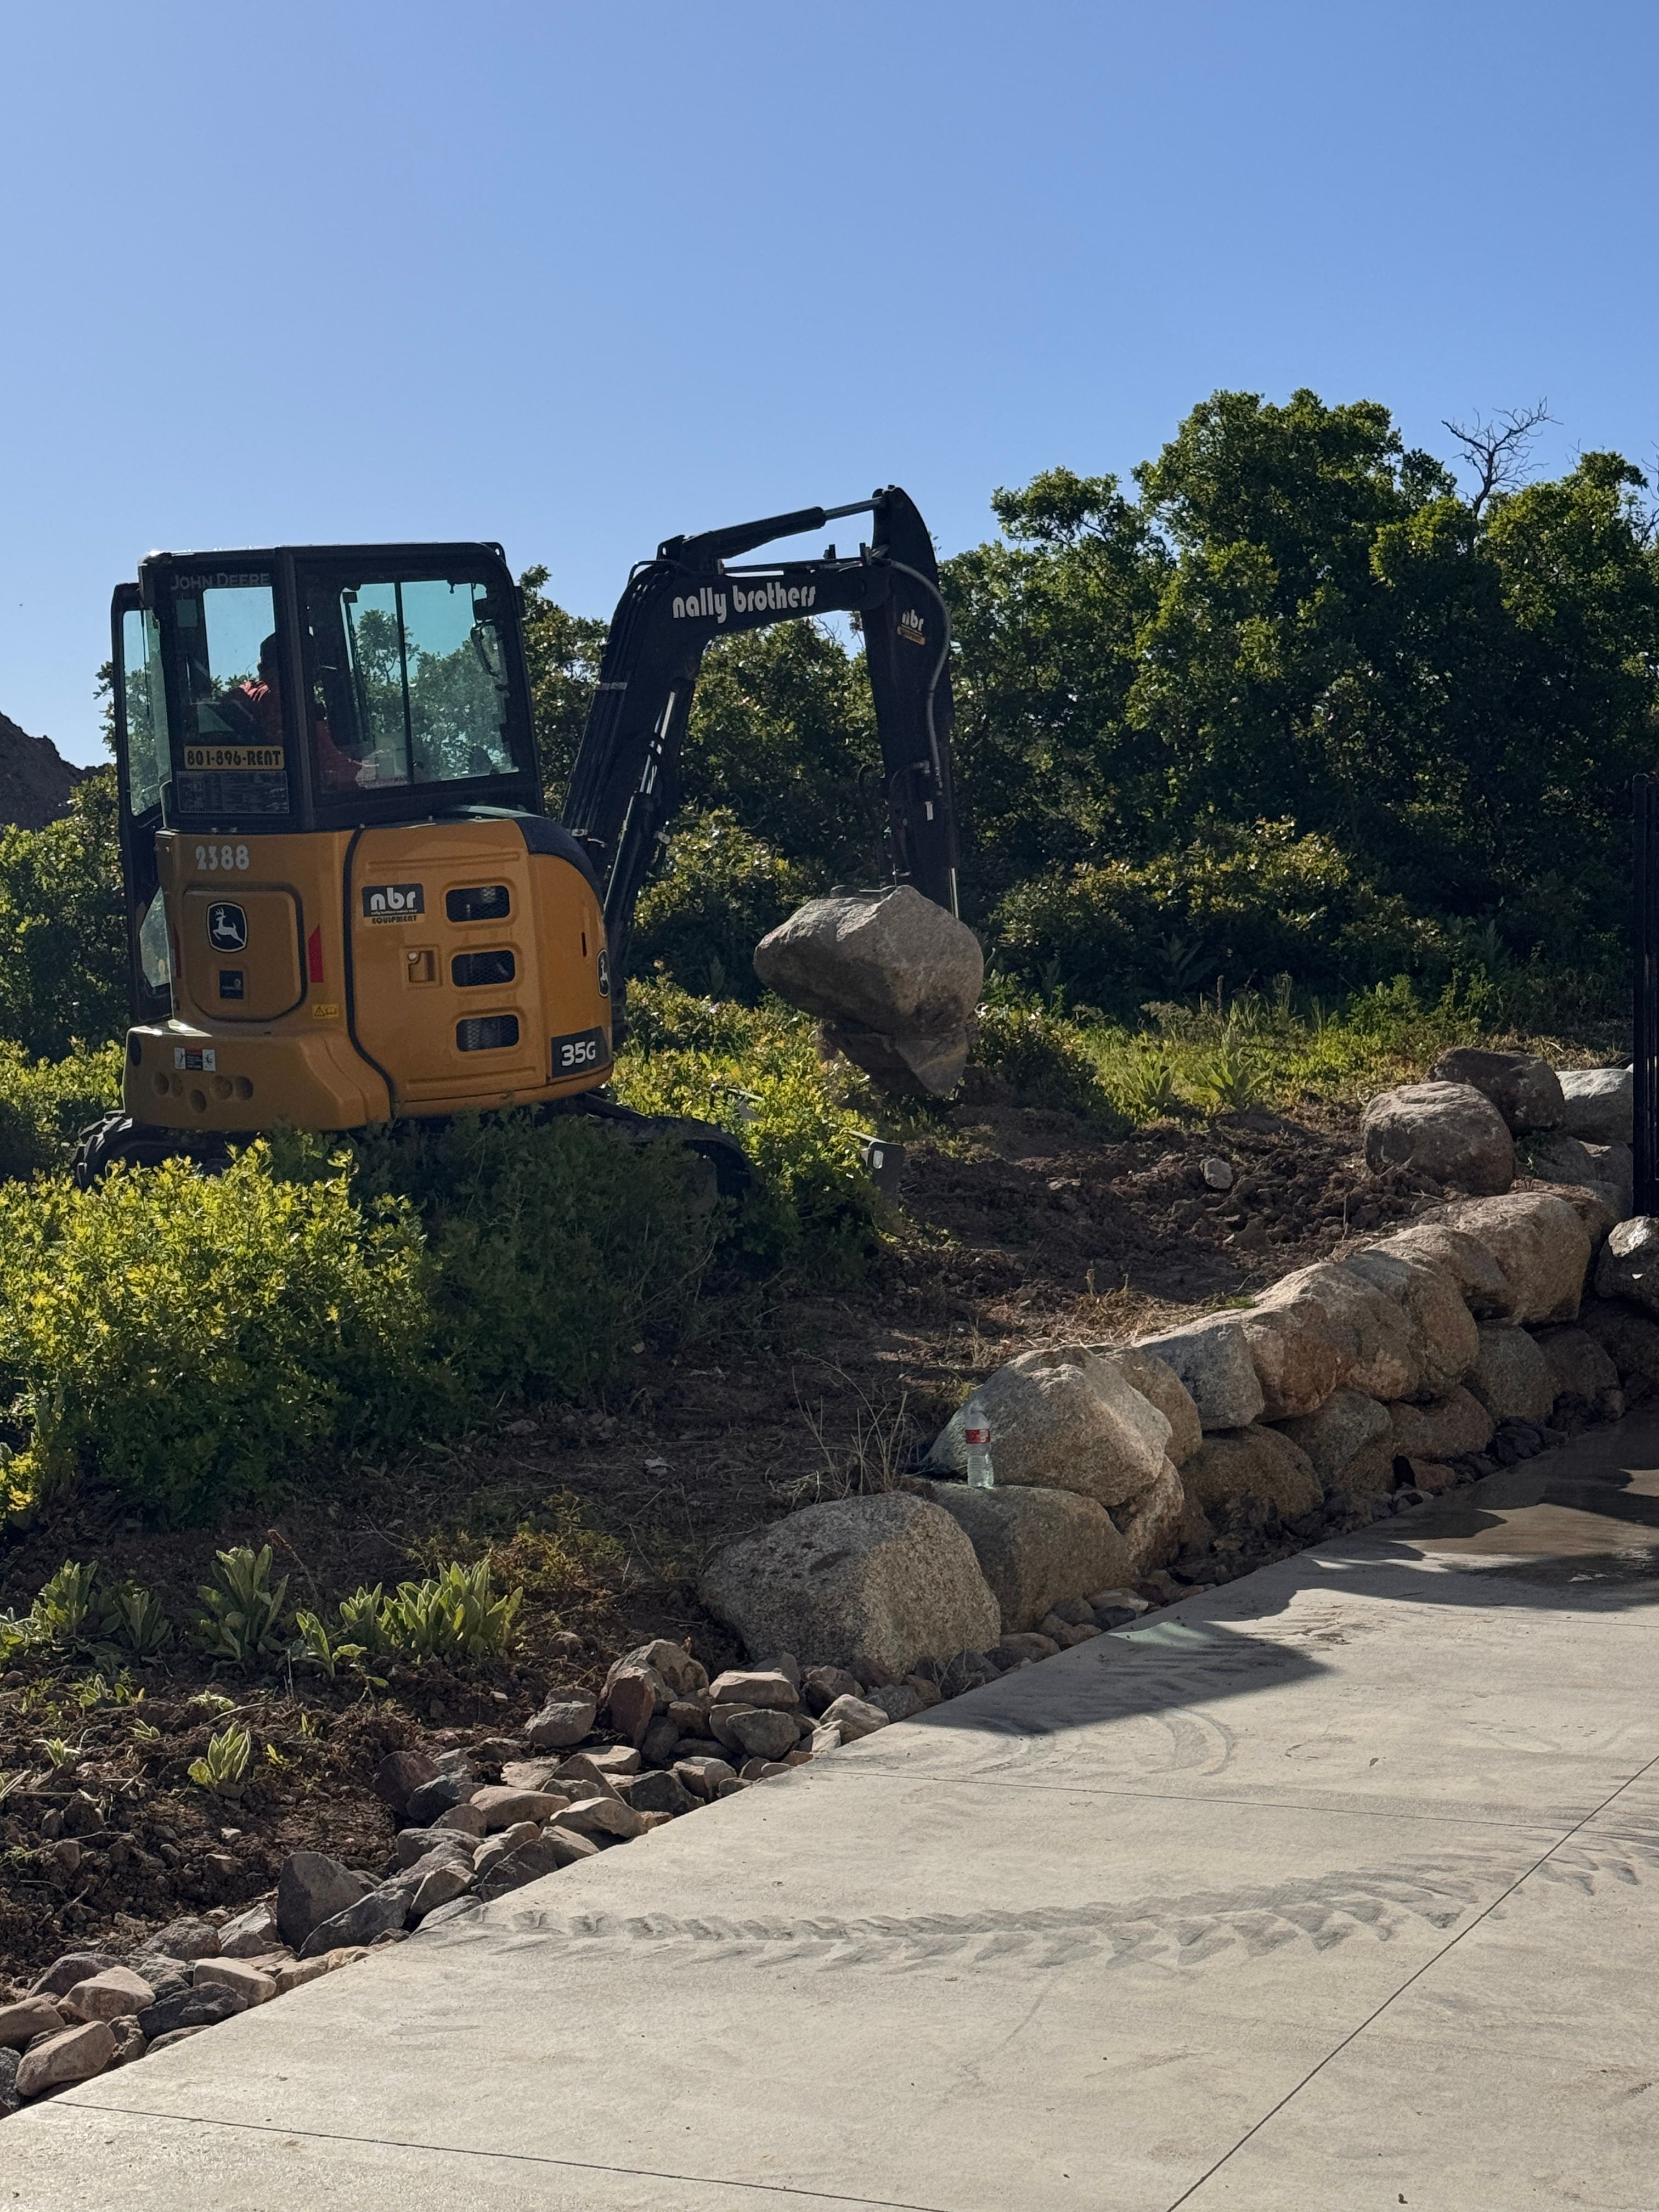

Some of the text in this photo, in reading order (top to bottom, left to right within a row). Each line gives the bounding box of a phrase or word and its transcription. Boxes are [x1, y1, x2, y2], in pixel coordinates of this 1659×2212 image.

[171, 573, 270, 590] JOHN DEERE
[673, 582, 816, 624] nally brothers
[901, 609, 924, 632] nbr
[187, 750, 281, 766] 801-896-RENT
[370, 887, 416, 911] nbr
[372, 915, 417, 924] EQUIPMENT
[561, 1041, 596, 1066] 35G
